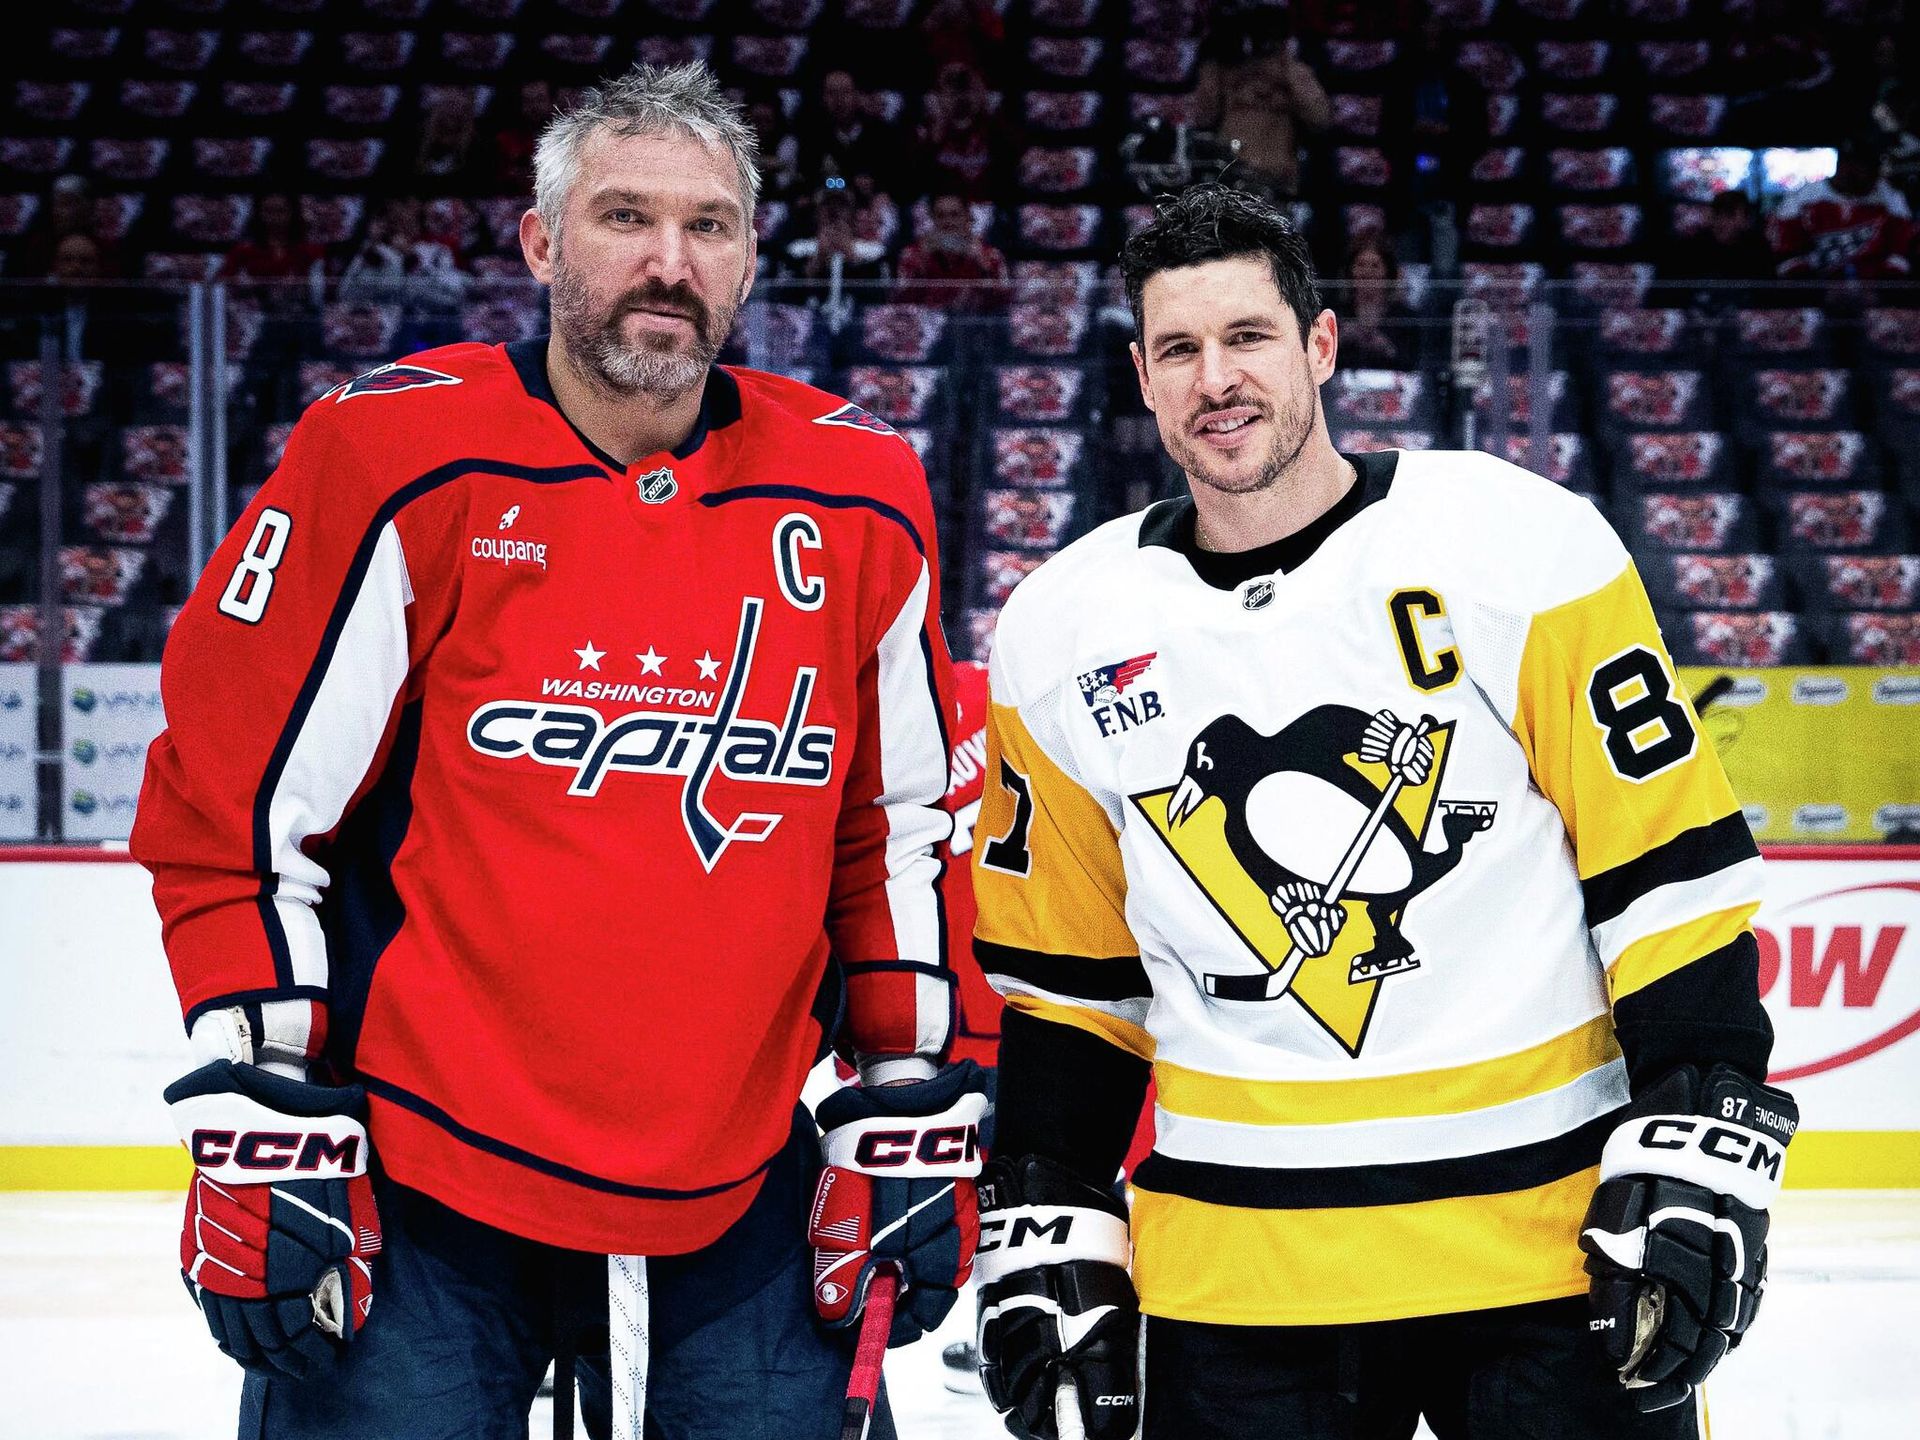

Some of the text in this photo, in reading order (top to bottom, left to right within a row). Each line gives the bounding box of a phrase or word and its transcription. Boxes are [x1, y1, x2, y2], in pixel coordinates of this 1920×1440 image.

[647, 477, 668, 499] NHL
[217, 505, 294, 627] 8
[471, 536, 547, 571] coupang
[772, 513, 826, 612] C
[1248, 586, 1272, 607] NHL
[1386, 586, 1464, 695] C
[541, 678, 716, 708] WASHINGTON
[1091, 691, 1166, 738] F.N.B.
[1585, 643, 1698, 785] 8
[1721, 1096, 1748, 1121] 87
[192, 1129, 361, 1173] CCM
[1638, 1119, 1782, 1182] CCM
[978, 1183, 996, 1208] 87
[1095, 1394, 1135, 1406] CCM
